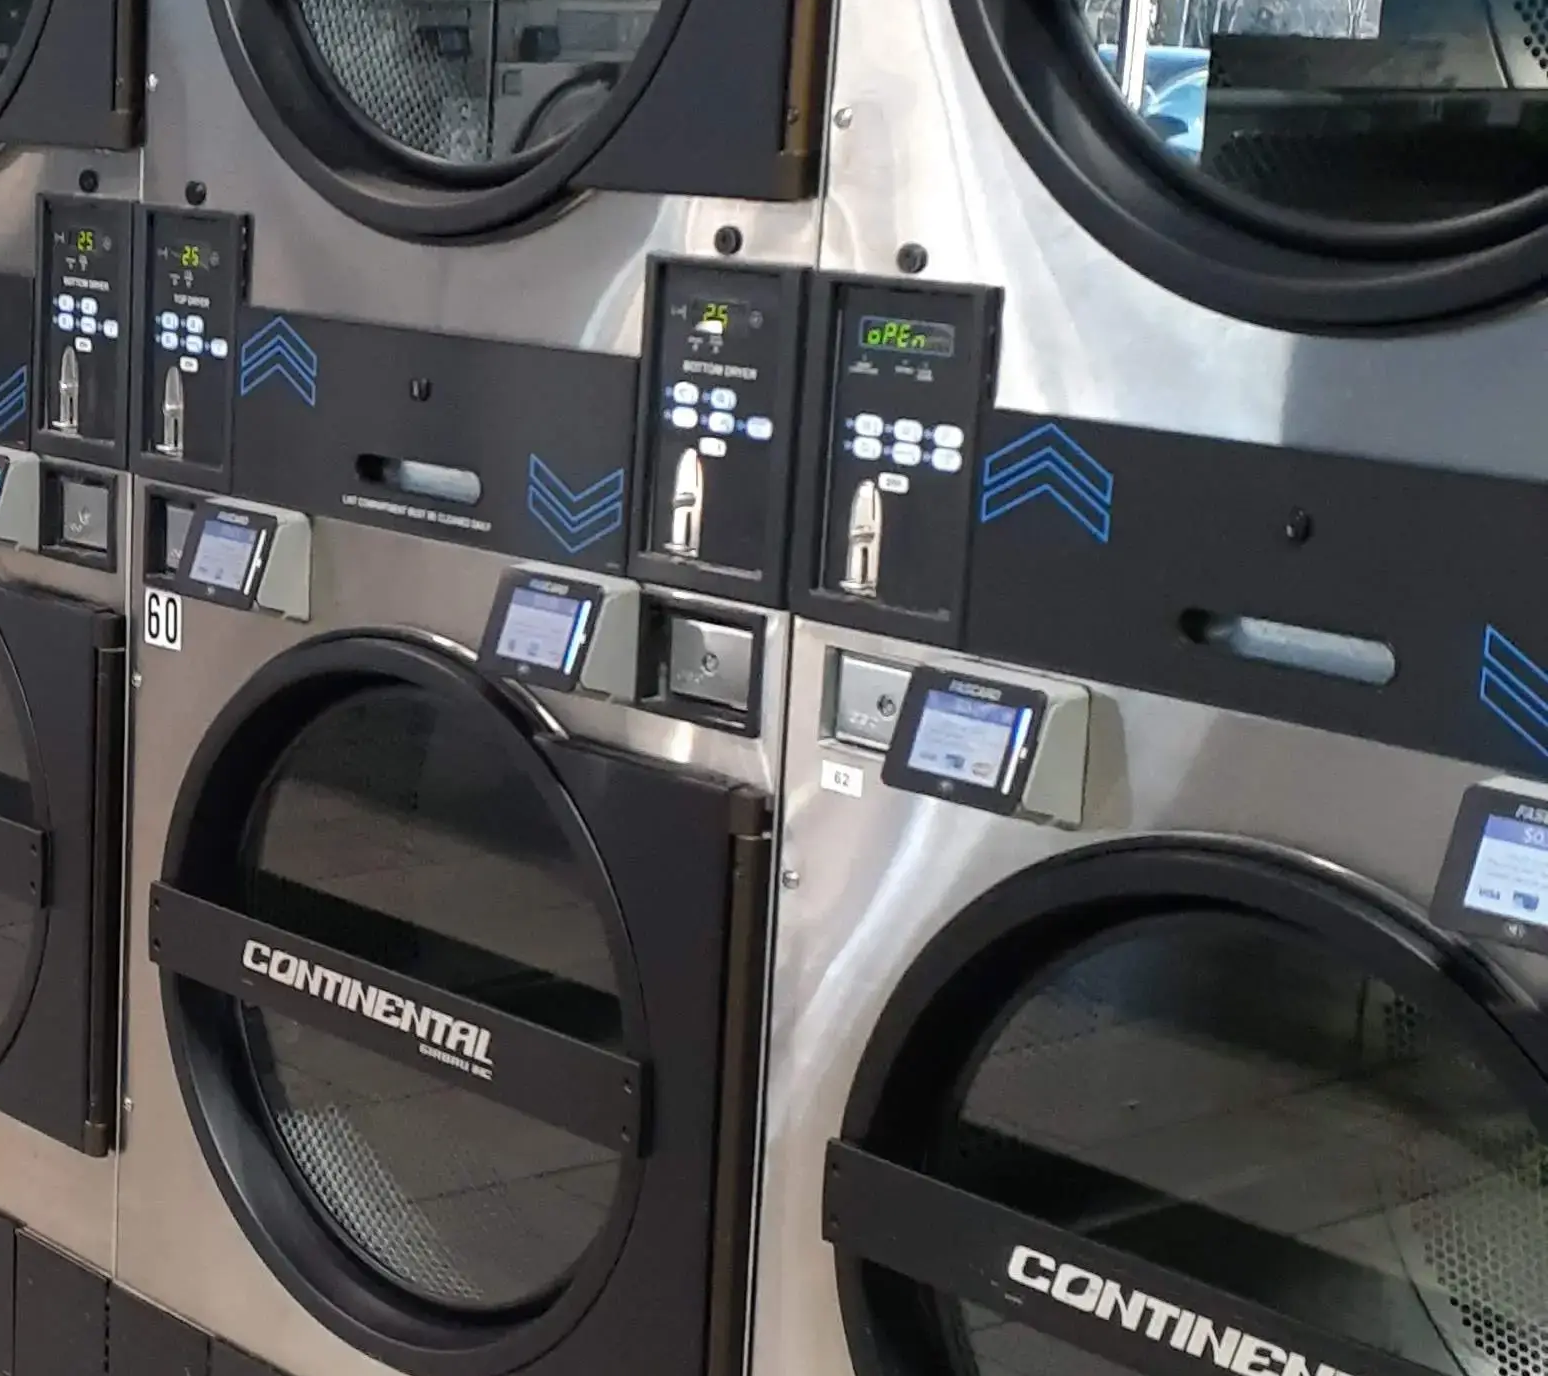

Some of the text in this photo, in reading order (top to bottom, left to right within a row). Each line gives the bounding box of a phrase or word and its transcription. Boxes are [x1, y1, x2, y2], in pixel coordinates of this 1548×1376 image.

[181, 245, 199, 266] 25
[147, 592, 178, 644] 60
[833, 769, 850, 787] 62
[1515, 804, 1548, 824] FAS
[242, 939, 494, 1066] CONTINENTAL
